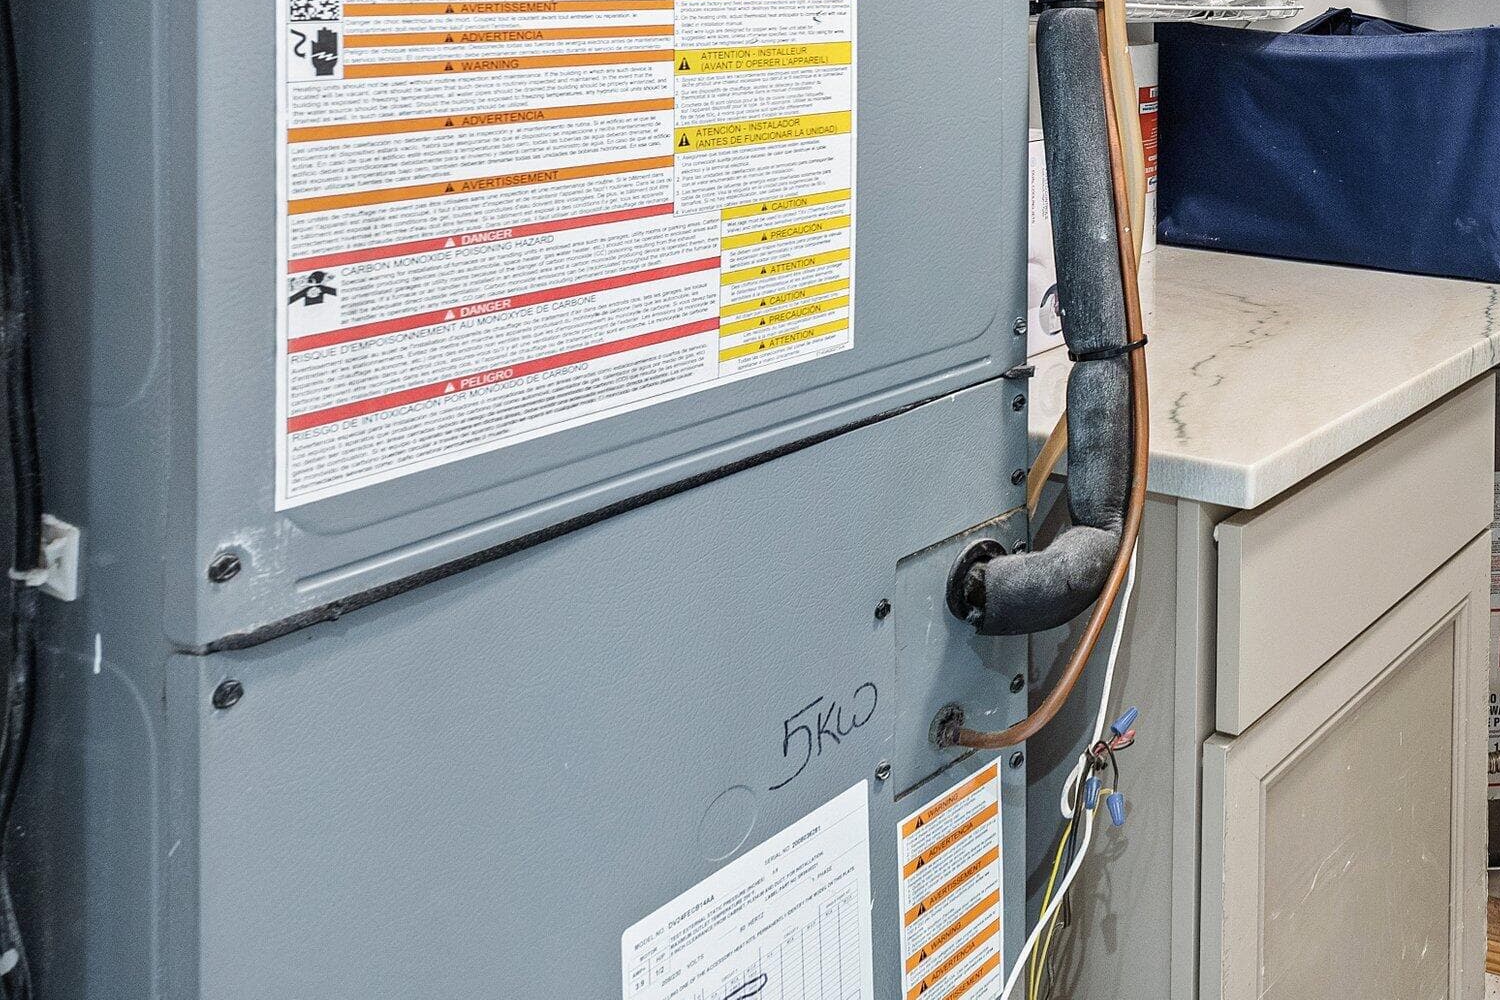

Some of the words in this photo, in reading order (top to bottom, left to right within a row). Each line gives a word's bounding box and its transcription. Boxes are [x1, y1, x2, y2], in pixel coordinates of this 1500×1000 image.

[460, 2, 557, 13] AVERTISSEMENT
[460, 30, 542, 42] ADVERTENCIA
[700, 49, 750, 60] ATTENTION
[757, 46, 806, 57] INSTALLEUR
[461, 58, 519, 71] WARNING
[700, 60, 732, 72] (AVANT
[461, 110, 544, 126] ADVERTENCIA
[748, 117, 800, 131] INSTALADOR
[695, 135, 728, 148] (ANTES
[730, 134, 741, 144] DE
[744, 129, 792, 142] FUNCIONAR
[794, 128, 804, 137] LA
[806, 124, 837, 136] UNIDAD)
[461, 170, 558, 191] AVERTISSEMENT
[771, 197, 807, 211] CAUTION
[461, 228, 512, 245] DANGER
[340, 259, 390, 277] CARBON
[393, 250, 453, 268] MONOXIDE
[454, 241, 512, 258] POISONING
[515, 234, 553, 249] HAZARD
[770, 257, 815, 273] ATTENTION
[769, 289, 805, 305] CAUTION
[460, 298, 511, 317] DANGER
[290, 346, 337, 365] RISQUE
[340, 323, 455, 354] D'EMPOISONNEMENT
[459, 319, 474, 330] AU
[477, 307, 533, 326] MONOXYDE
[535, 304, 549, 314] DE
[552, 294, 596, 310] CARBONE
[768, 328, 814, 347] ATTENTION
[460, 367, 513, 390] PELIGRO
[292, 423, 339, 443] RIESGO
[341, 418, 358, 431] DE
[444, 392, 465, 405] POR
[526, 374, 540, 384] DE
[542, 362, 588, 380] CARBONO
[926, 790, 958, 820] WARNING
[928, 819, 973, 860] ADVERTENCIA
[929, 860, 981, 907] AVERTISSEMENT
[930, 920, 960, 952] WARNING
[930, 940, 974, 983] ADVERTENCIA
